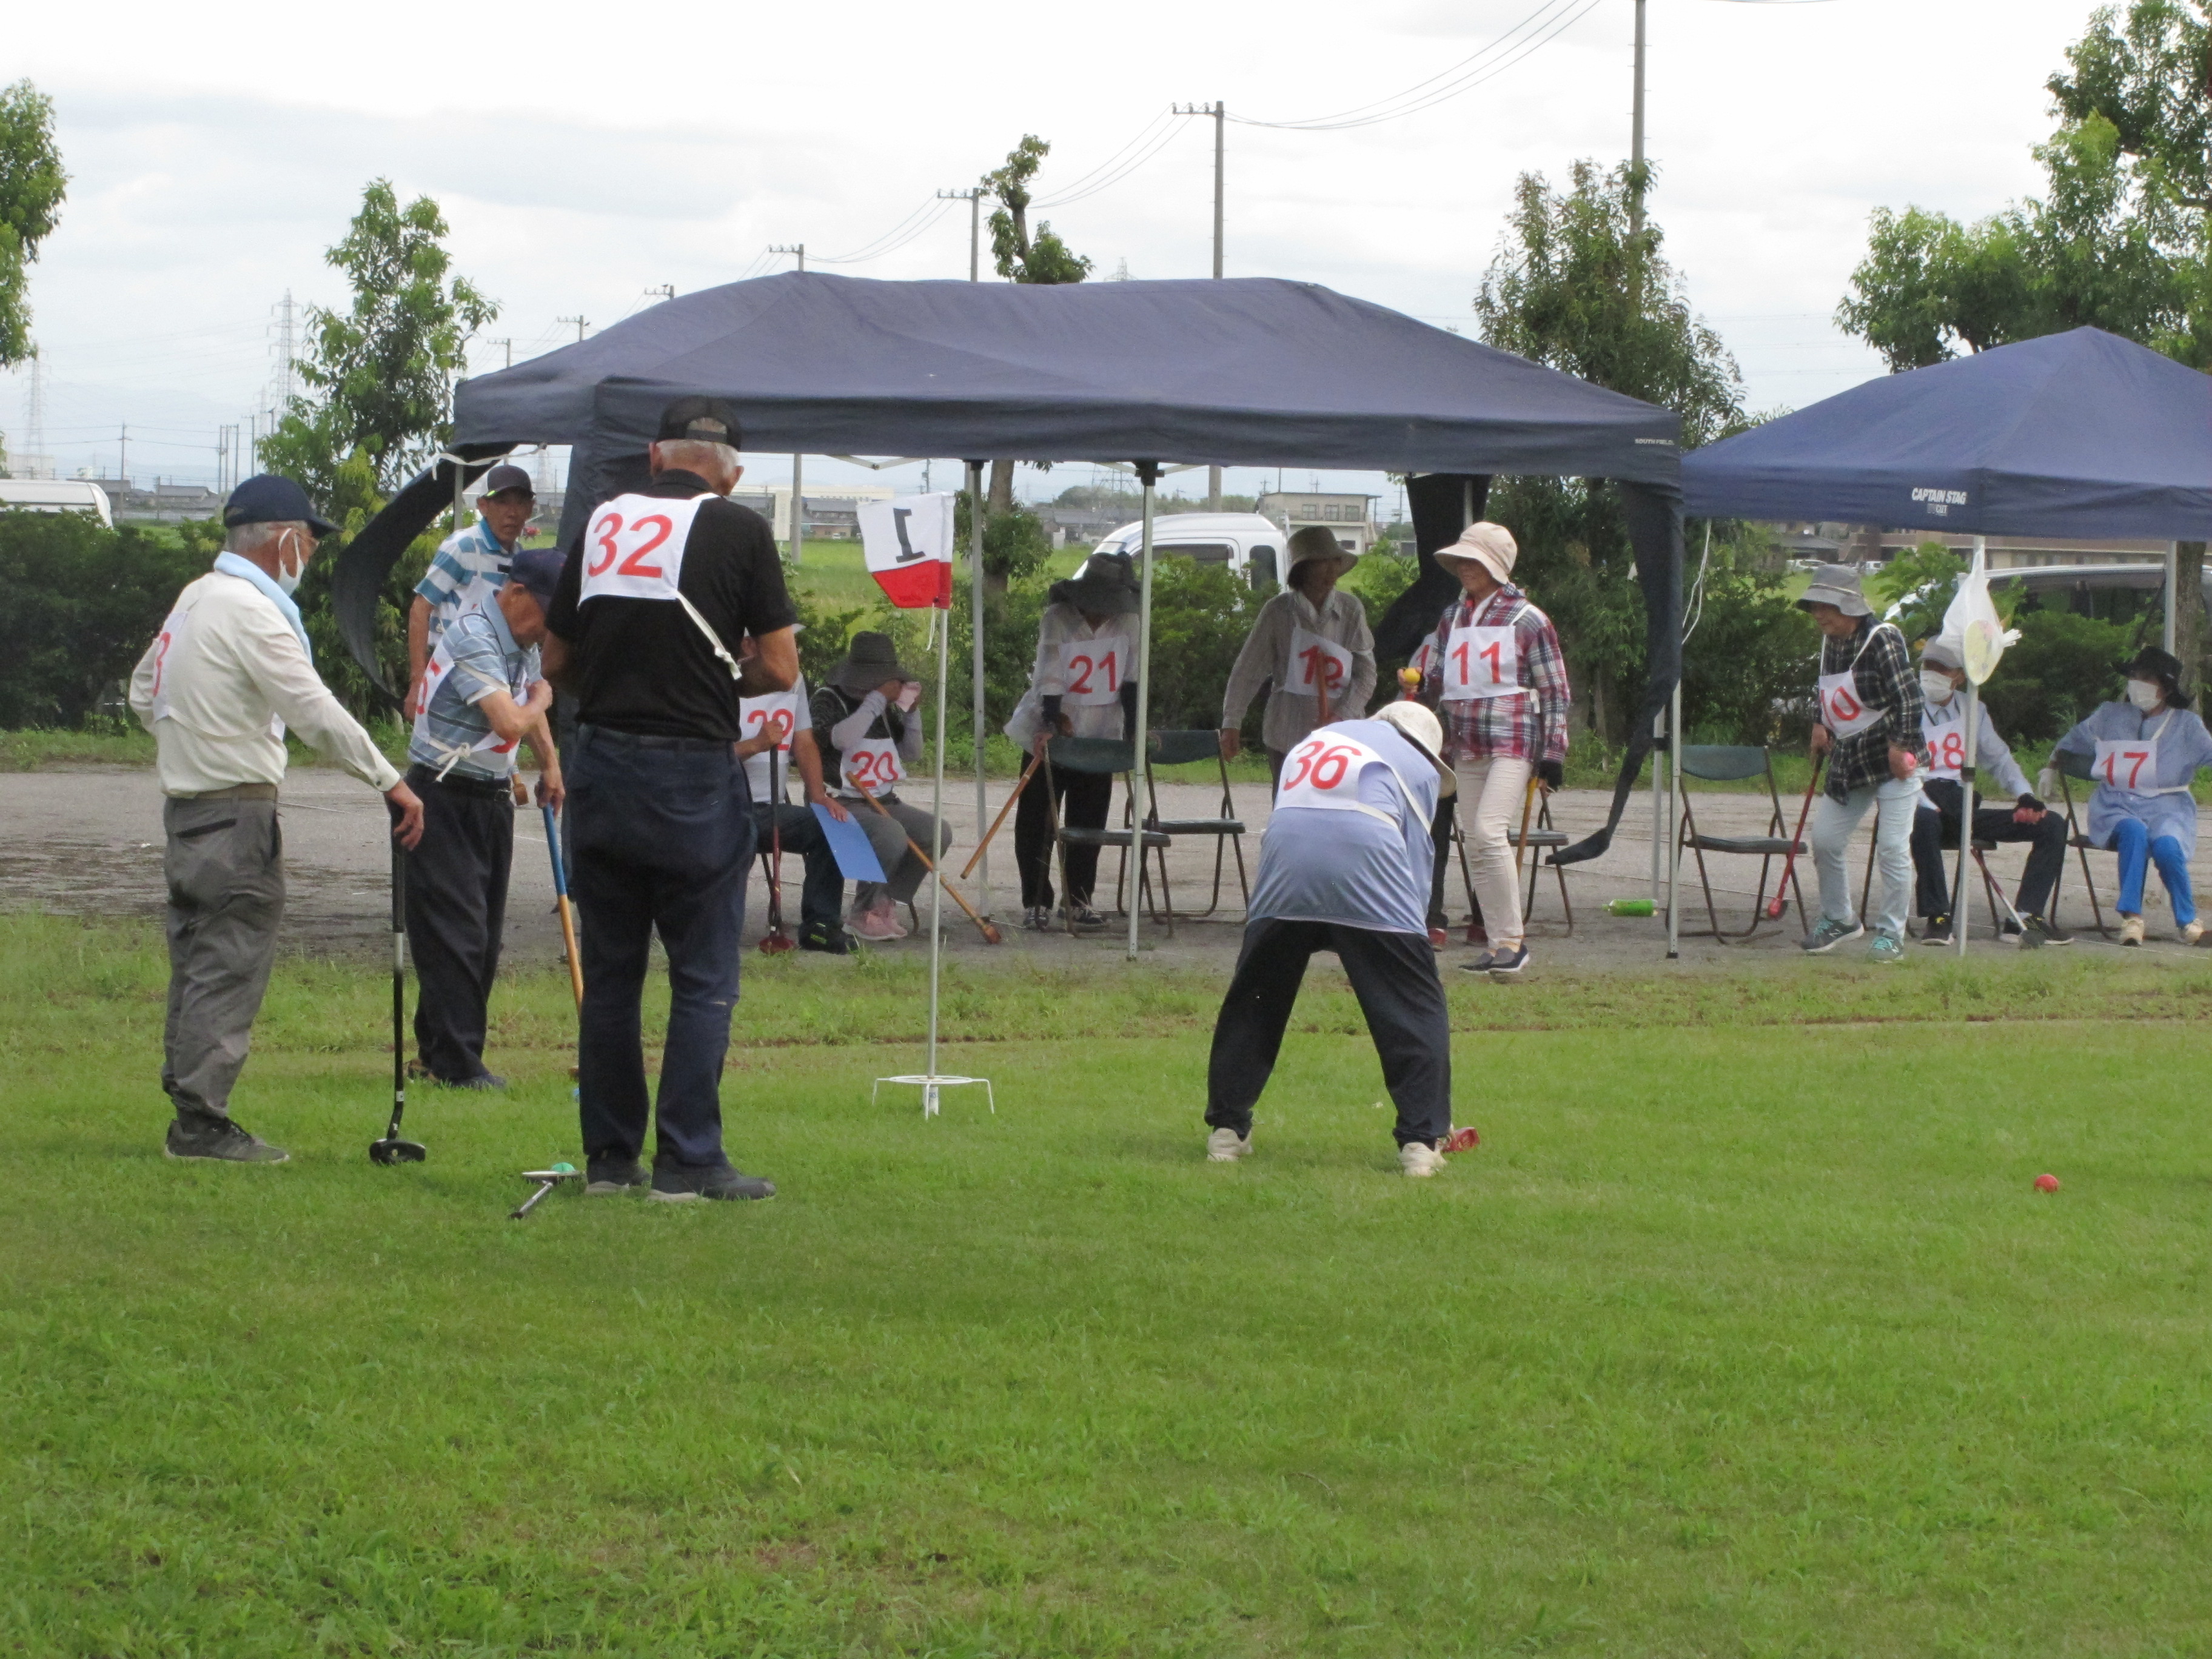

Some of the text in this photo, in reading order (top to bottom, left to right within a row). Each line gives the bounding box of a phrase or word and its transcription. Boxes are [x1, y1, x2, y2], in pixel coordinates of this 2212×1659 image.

[1912, 488, 1967, 505] CAPTAIN STAG
[588, 512, 672, 578] 32
[1068, 651, 1116, 694] 21
[1452, 641, 1501, 685] 11
[850, 751, 899, 788] 20
[1283, 740, 1362, 791] 36
[1928, 732, 1966, 771] 18
[2100, 751, 2149, 789] 17
